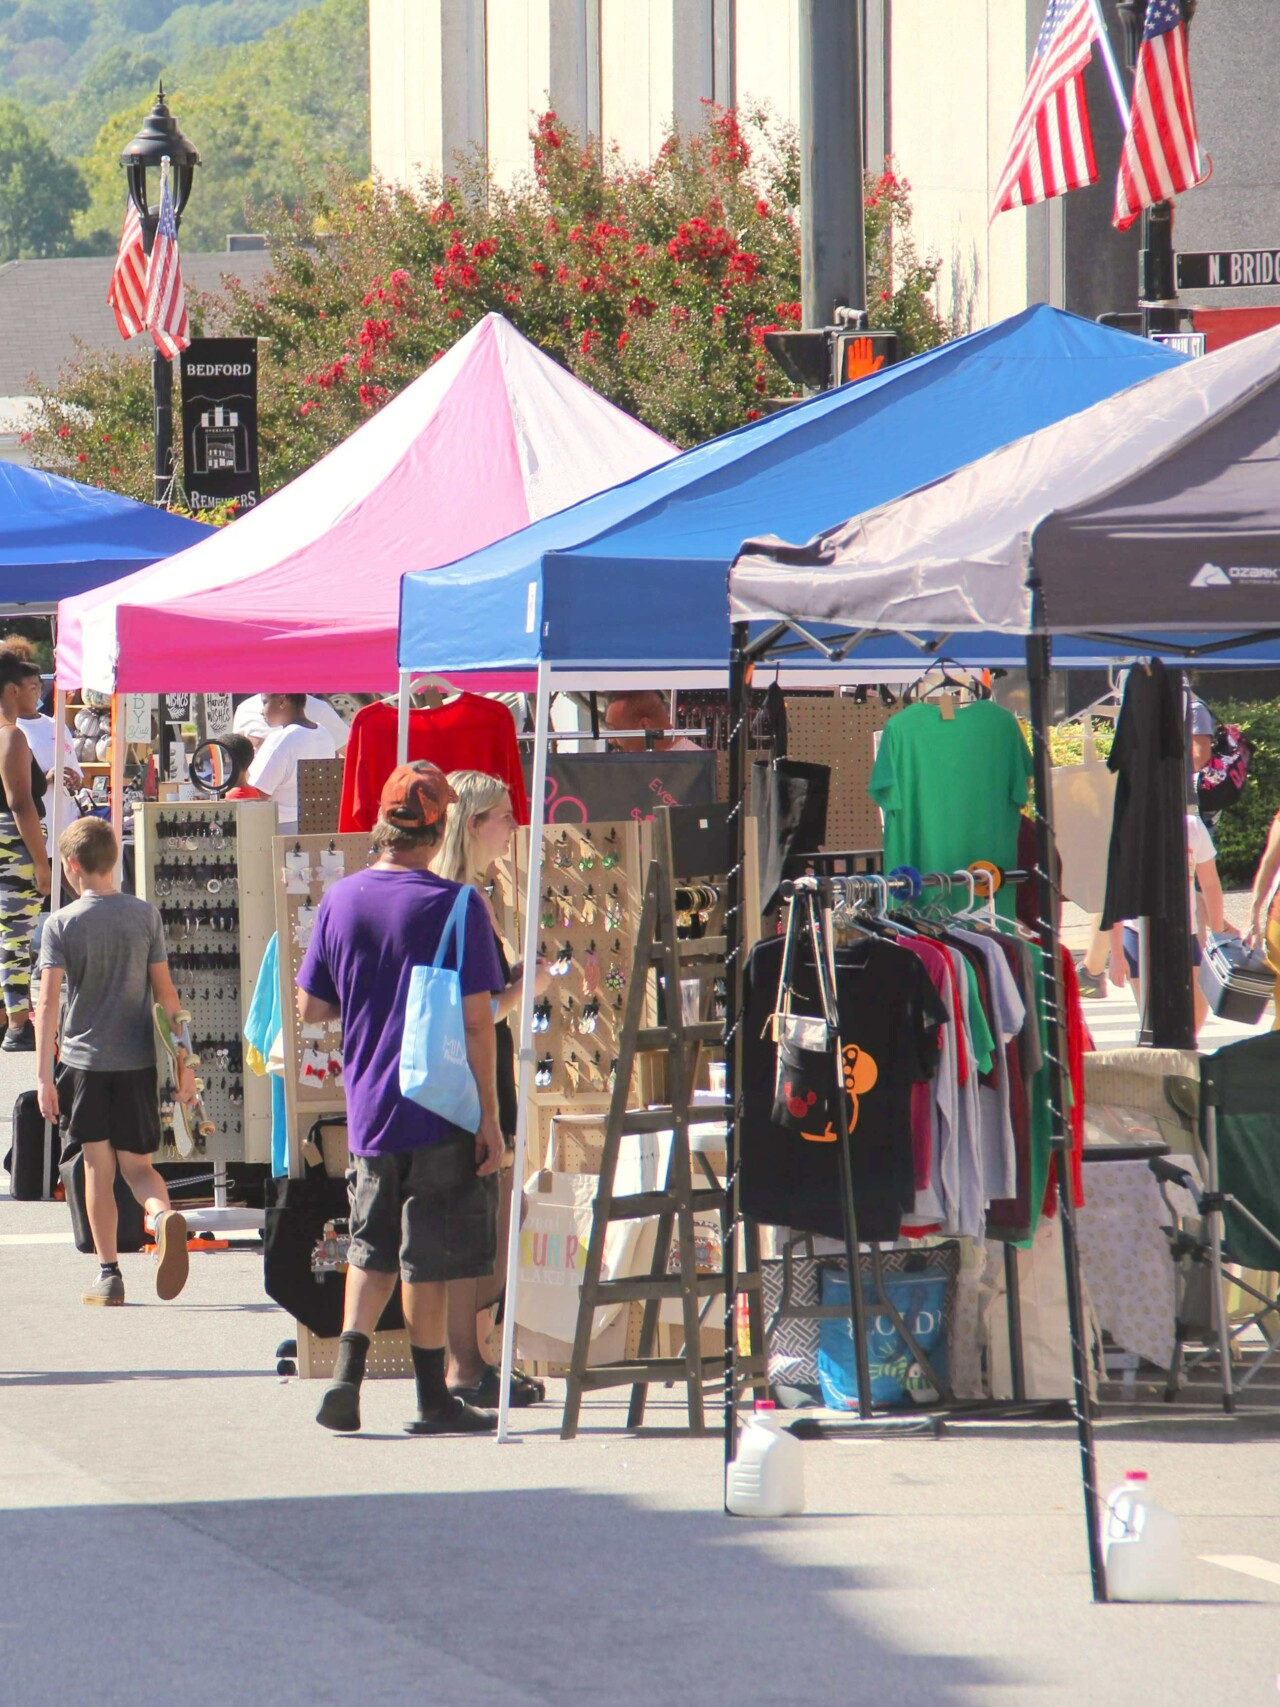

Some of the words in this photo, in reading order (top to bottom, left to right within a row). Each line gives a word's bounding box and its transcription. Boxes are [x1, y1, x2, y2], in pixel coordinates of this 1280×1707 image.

[1209, 254, 1225, 285] N.
[187, 364, 252, 376] BEDFORD
[132, 693, 145, 724] DY
[521, 1230, 562, 1268] SUN
